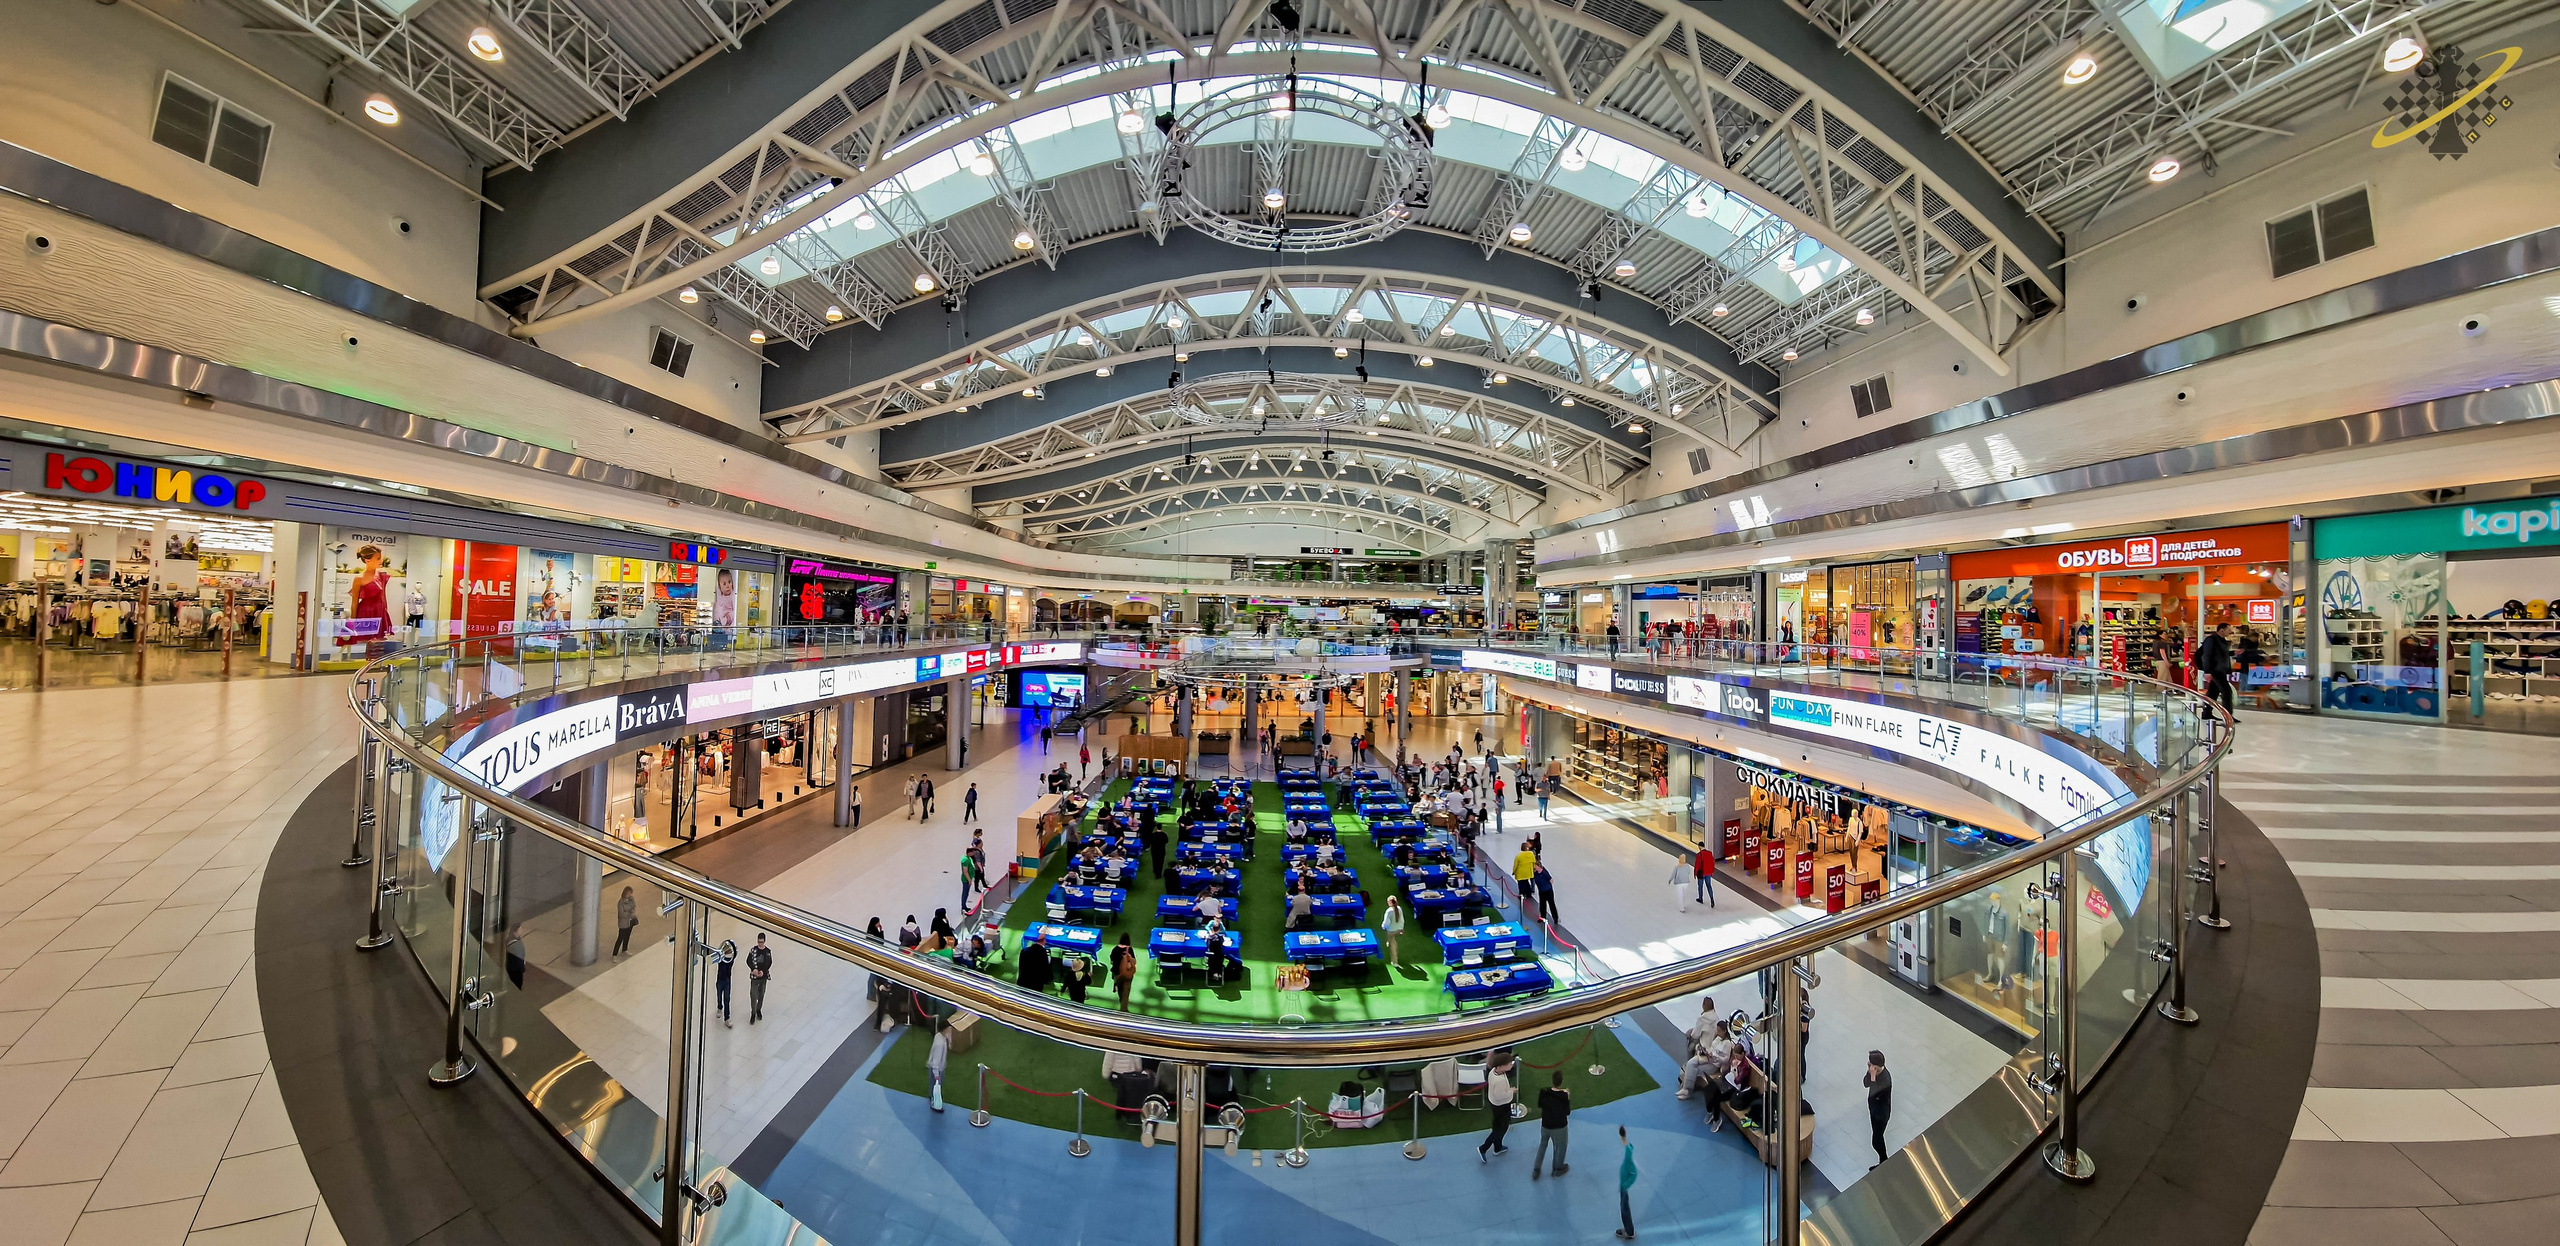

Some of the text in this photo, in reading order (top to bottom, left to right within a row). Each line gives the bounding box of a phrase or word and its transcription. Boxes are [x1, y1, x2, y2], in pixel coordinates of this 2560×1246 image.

[45, 452, 267, 510] ЮНИОР
[351, 533, 396, 545] mayoral
[2160, 539, 2216, 554] ДЛЯ ДЕТЕЙ
[538, 551, 567, 560] mayoral
[670, 542, 727, 565] ЮНИОР
[2058, 548, 2124, 569] ОБУВЬ
[2161, 553, 2169, 561] И
[2170, 548, 2242, 561] ПОДРОСТКОВ
[458, 579, 512, 597] SALE
[1557, 667, 1576, 680] GUESS
[481, 731, 541, 789] TOUS
[548, 715, 611, 751] MARELLA
[619, 692, 686, 732] BrávA
[1771, 696, 1795, 711] FUN
[1806, 701, 1832, 717] DAY
[1834, 712, 1863, 728] FINN
[1866, 718, 1903, 738] FLARE
[1918, 718, 1961, 756] EA7
[1981, 749, 2045, 793] FALKE
